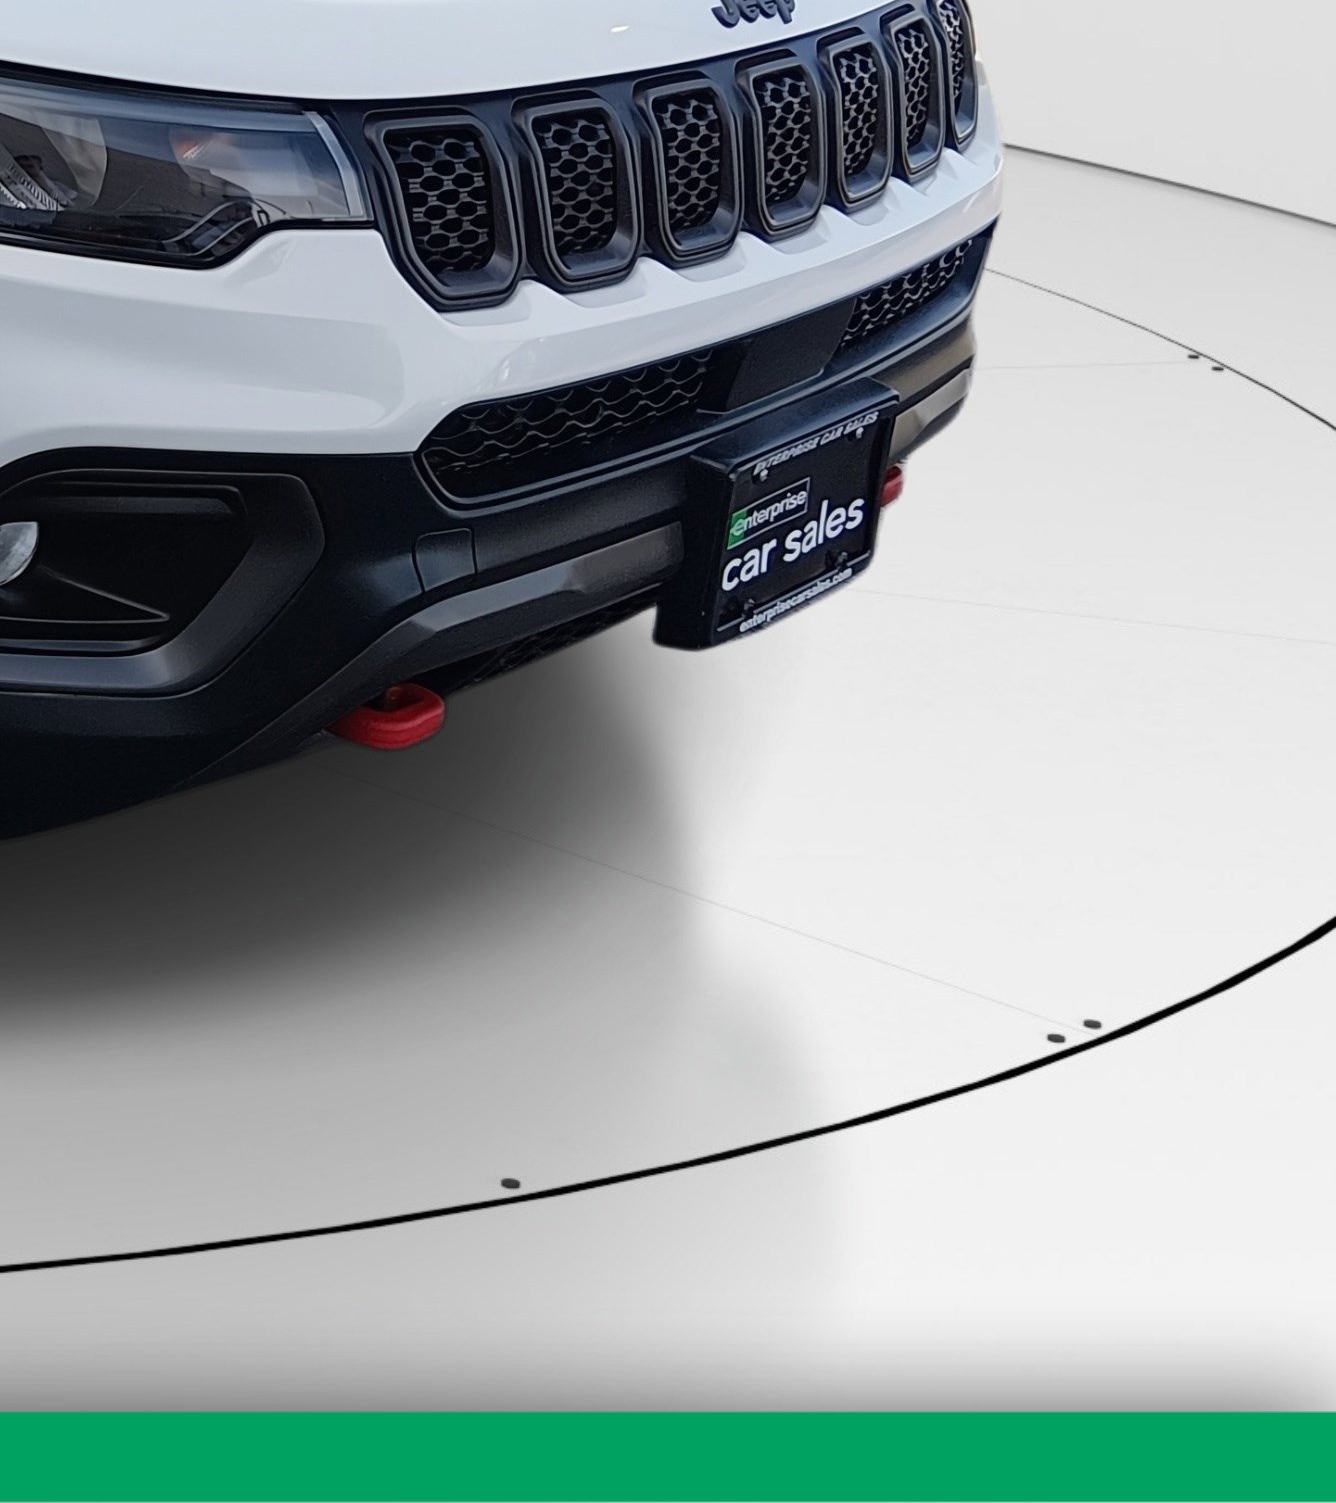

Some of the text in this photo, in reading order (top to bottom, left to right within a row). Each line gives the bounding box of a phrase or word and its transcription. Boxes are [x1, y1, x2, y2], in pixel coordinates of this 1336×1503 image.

[820, 426, 844, 445] CAR
[730, 491, 808, 536] enterprise
[722, 498, 865, 591] car sales
[739, 568, 853, 632] enterprisecarsales.com
